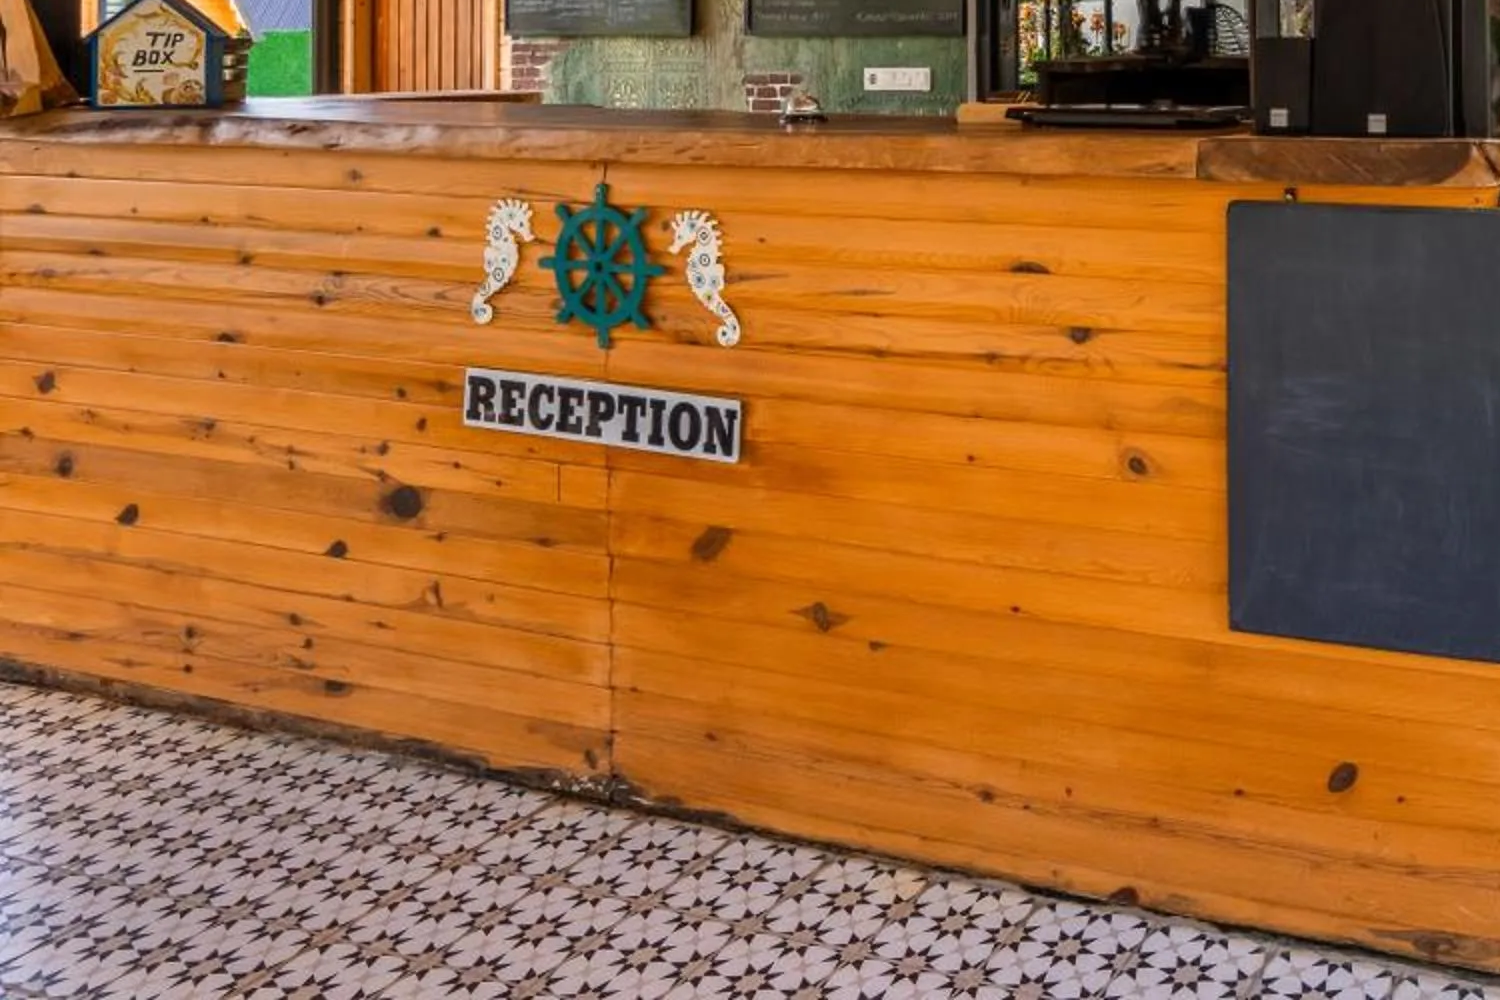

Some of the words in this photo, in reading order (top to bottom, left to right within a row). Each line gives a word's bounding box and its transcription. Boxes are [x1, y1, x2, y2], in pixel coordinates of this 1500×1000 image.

[145, 31, 185, 48] TIP
[132, 49, 175, 67] BOX
[466, 375, 738, 457] RECEPTION
